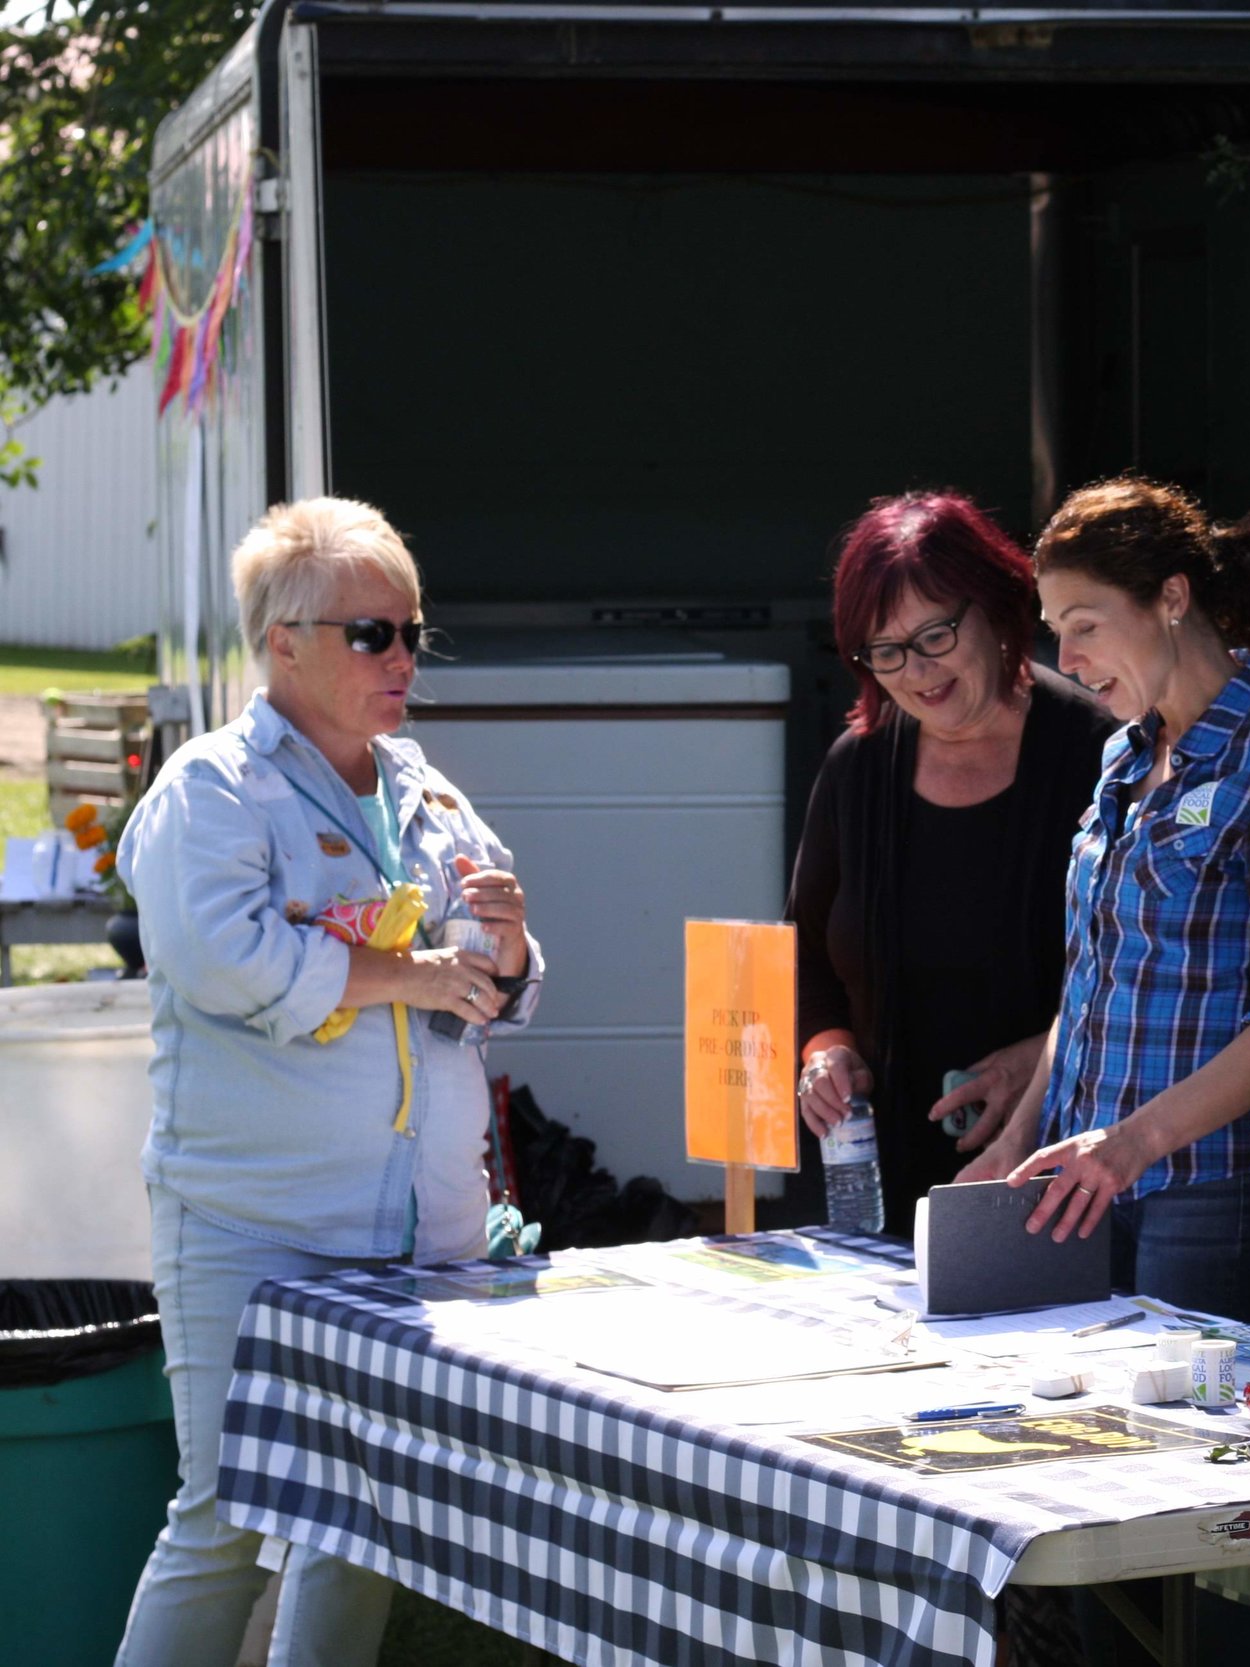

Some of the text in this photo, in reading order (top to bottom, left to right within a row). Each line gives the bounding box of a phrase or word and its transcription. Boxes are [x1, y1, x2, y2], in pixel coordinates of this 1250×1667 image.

[1183, 799, 1210, 807] FOOD
[712, 1009, 760, 1027] PICK UP
